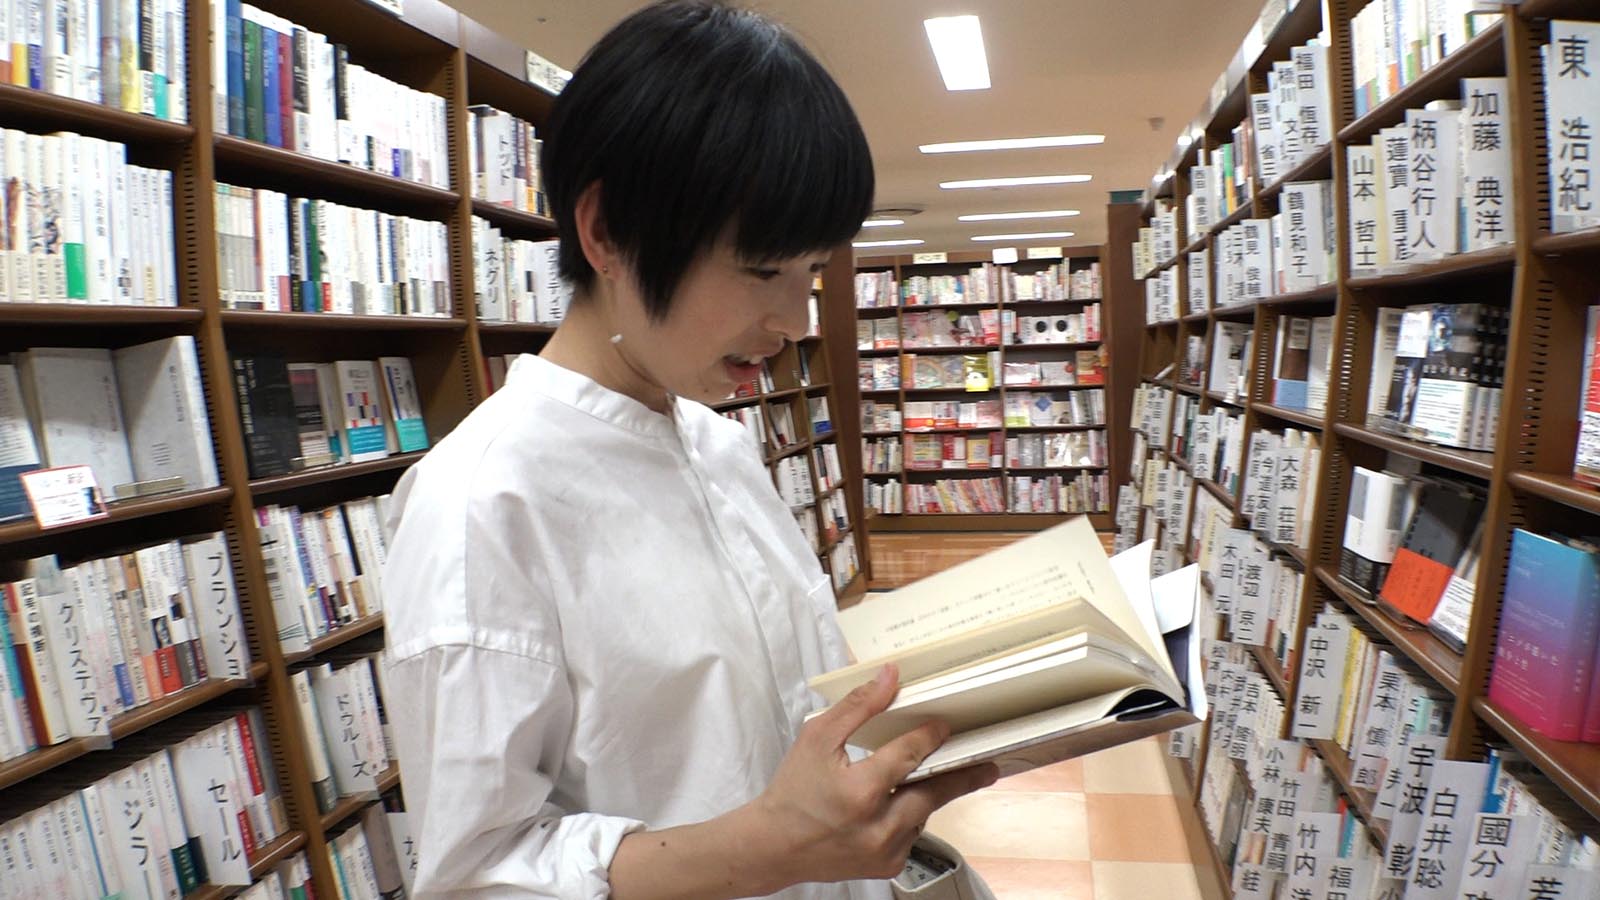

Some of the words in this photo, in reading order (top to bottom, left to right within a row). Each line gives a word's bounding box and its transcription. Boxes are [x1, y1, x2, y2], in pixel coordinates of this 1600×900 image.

[1411, 117, 1438, 249] 柄谷行人
[485, 250, 499, 304] ネグリ
[1287, 191, 1308, 274] 鶴見和子
[207, 551, 240, 676] ブランショ
[60, 602, 101, 733] クリステヴァ
[207, 778, 241, 863] セール
[1413, 787, 1459, 889] 白井聡
[1464, 816, 1513, 900] 國分
